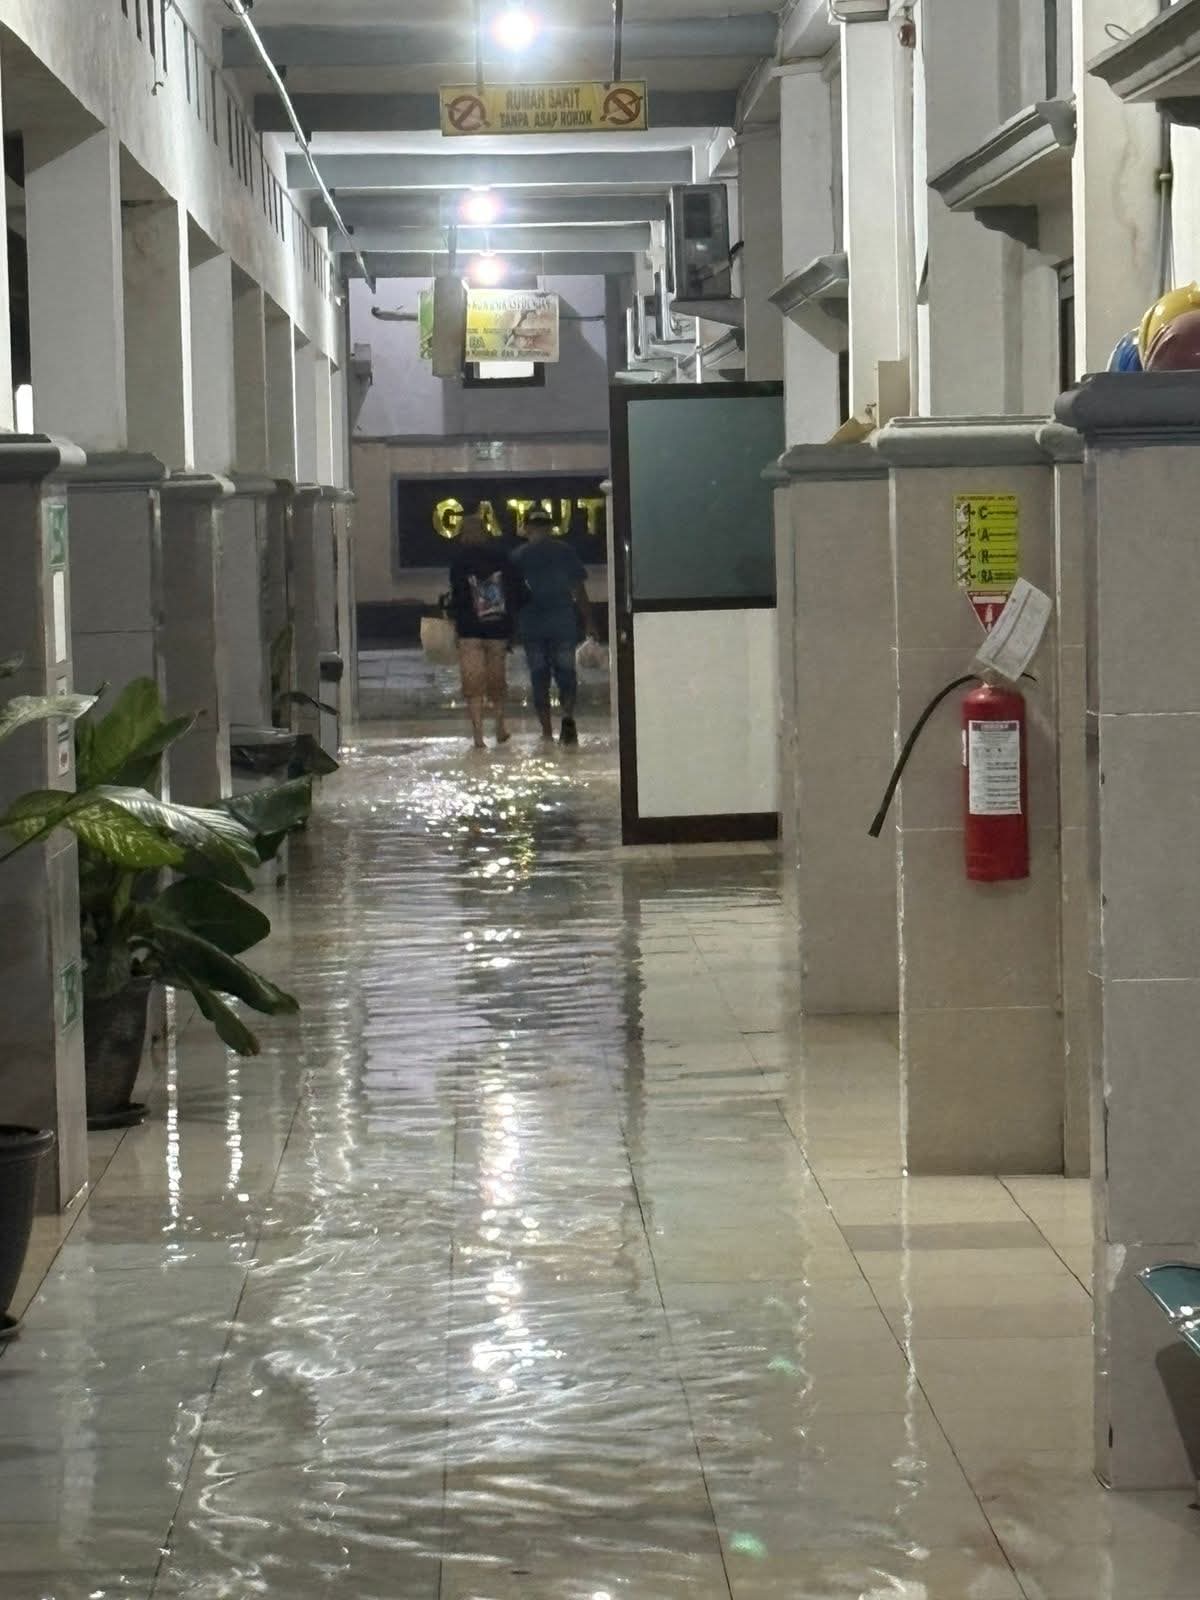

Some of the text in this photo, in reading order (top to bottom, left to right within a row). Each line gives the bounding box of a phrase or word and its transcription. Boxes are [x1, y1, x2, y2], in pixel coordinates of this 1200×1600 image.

[506, 87, 581, 110] RUMAH SAKIT
[499, 110, 593, 128] TANPA ASAP ROKOK
